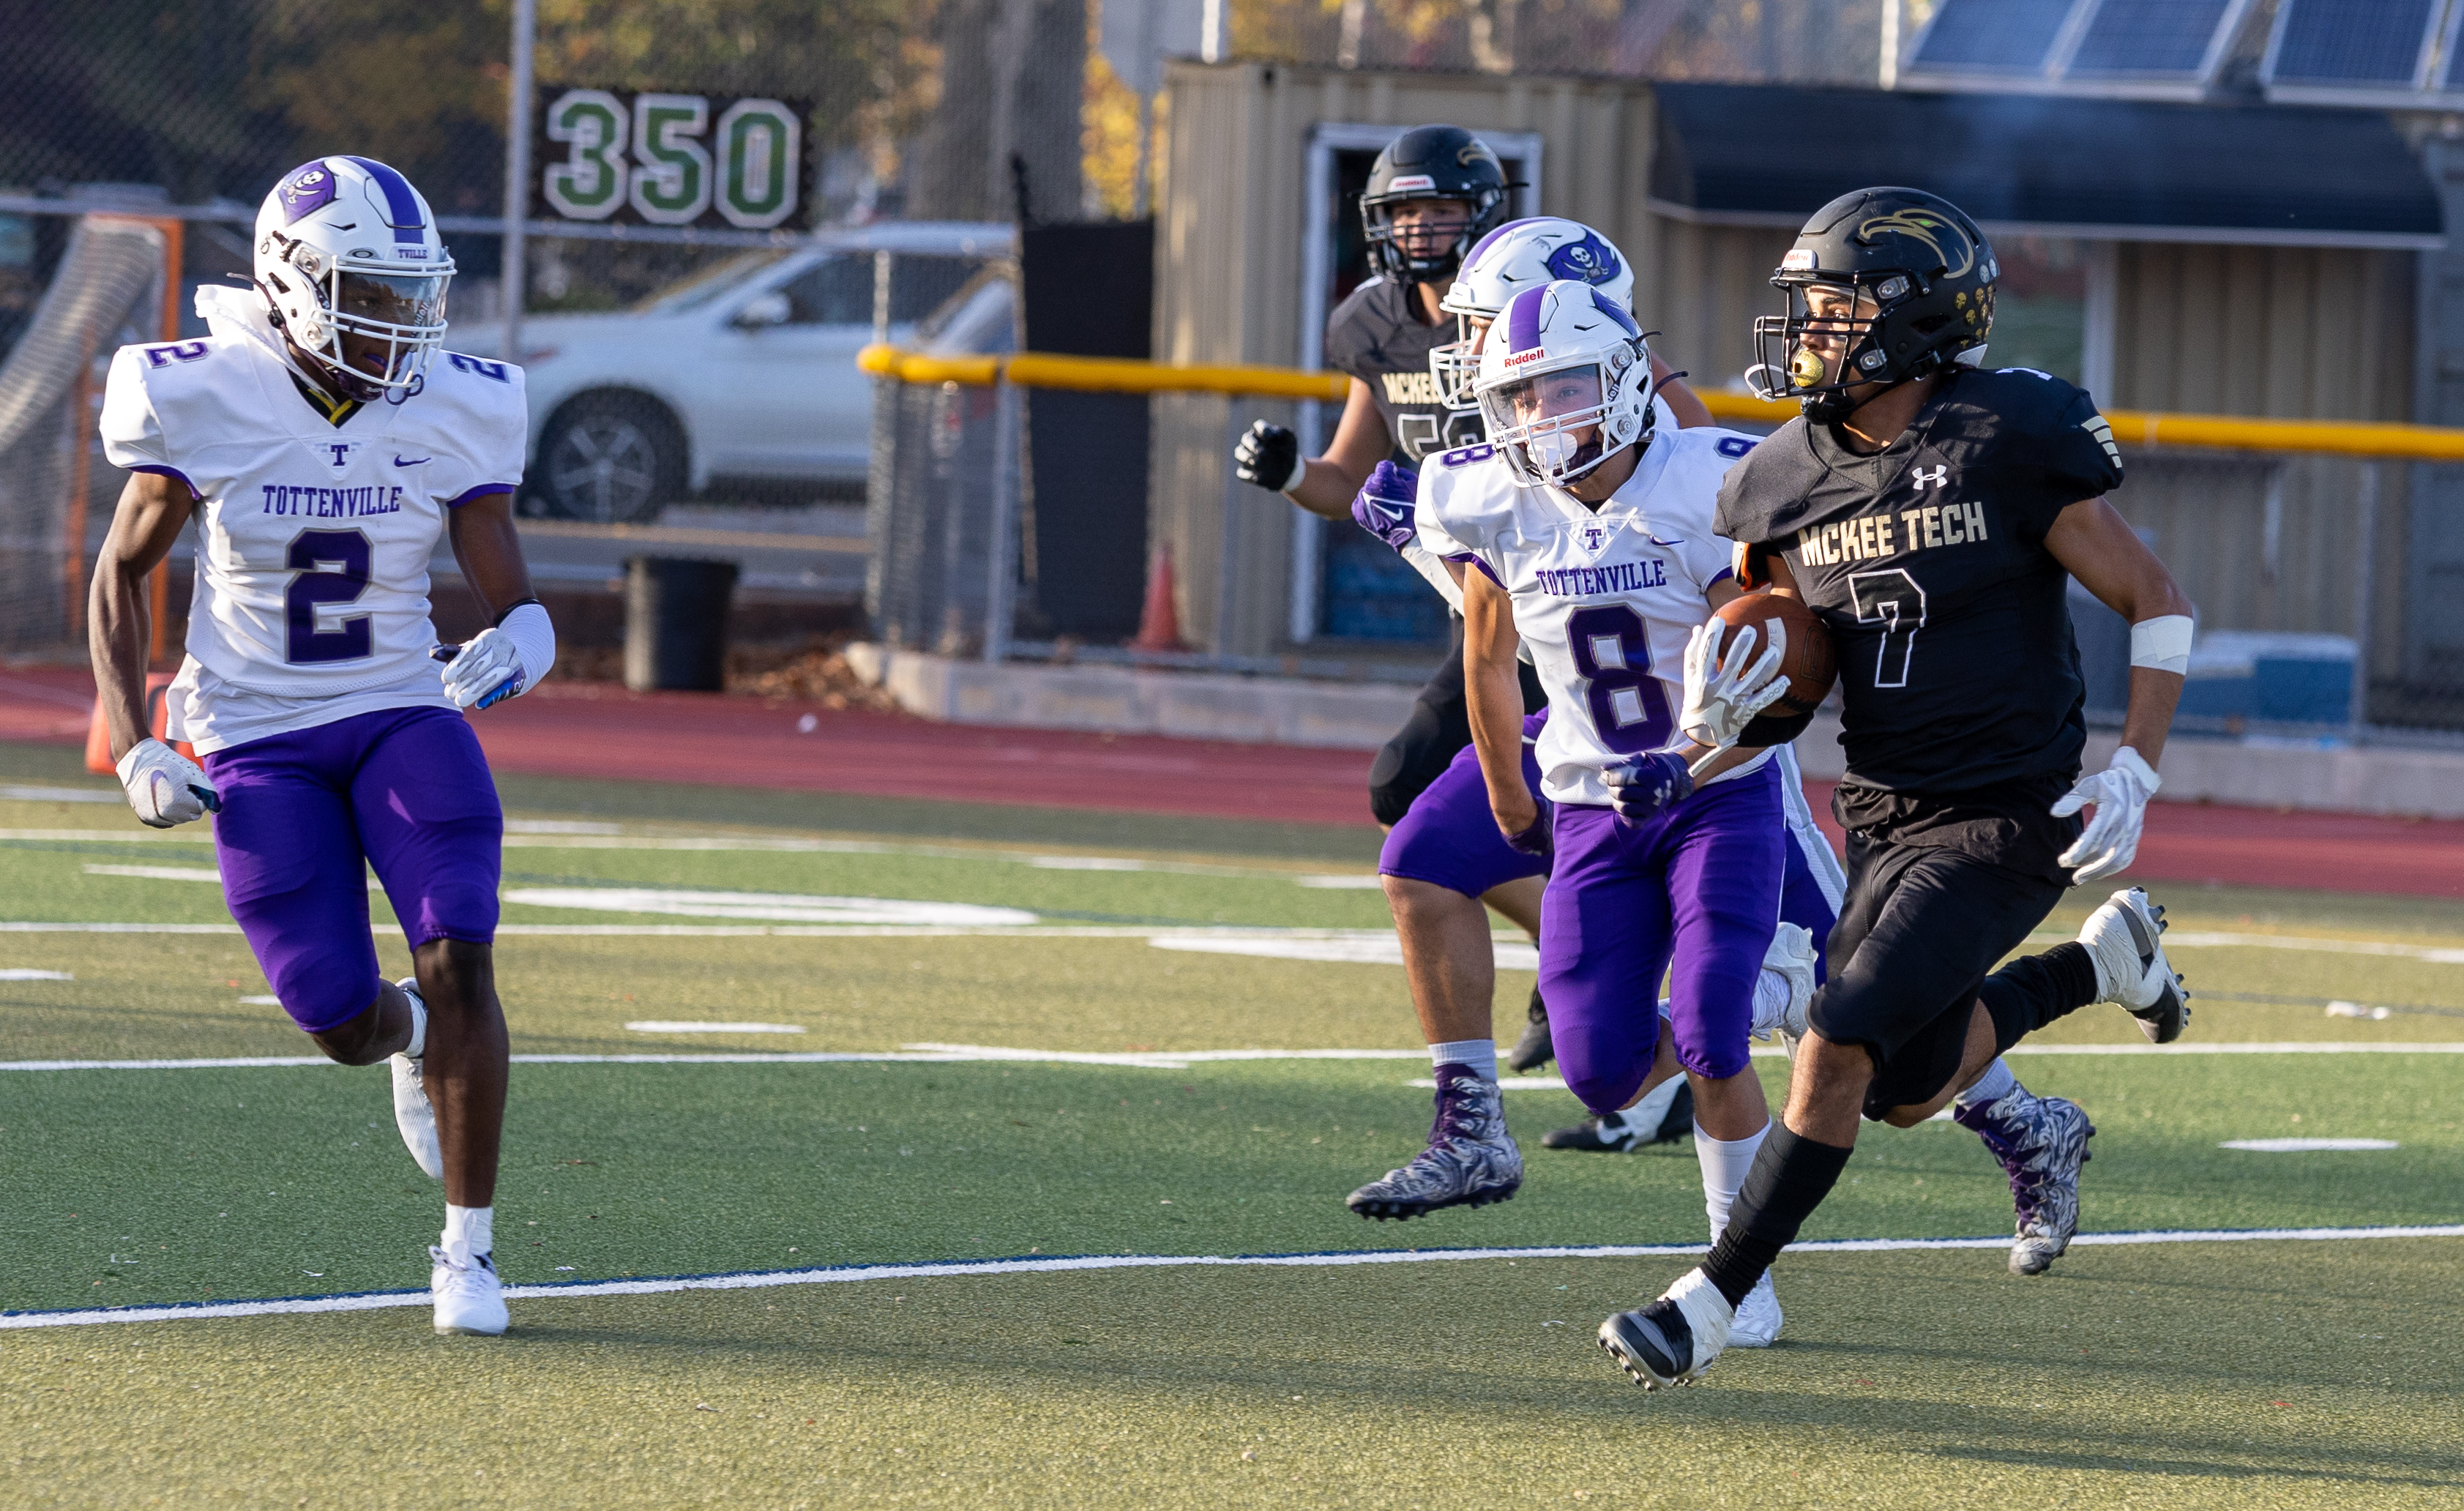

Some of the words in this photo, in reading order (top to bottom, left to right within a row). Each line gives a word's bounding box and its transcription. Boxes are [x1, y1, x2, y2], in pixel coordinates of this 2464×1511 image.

[544, 89, 802, 229] 350
[144, 342, 211, 369] 2
[1504, 348, 1545, 368] Riddell
[330, 444, 349, 467] T
[1440, 444, 1496, 470] 8
[262, 485, 403, 518] TOTTENVILLE
[1585, 528, 1602, 550] T
[1797, 514, 1895, 567] MCKEE
[1901, 501, 1988, 551] TECH
[1535, 559, 1667, 595] TOTTENVILLE
[283, 526, 374, 665] 2
[1848, 567, 1927, 688] 7
[1564, 601, 1680, 755] 8
